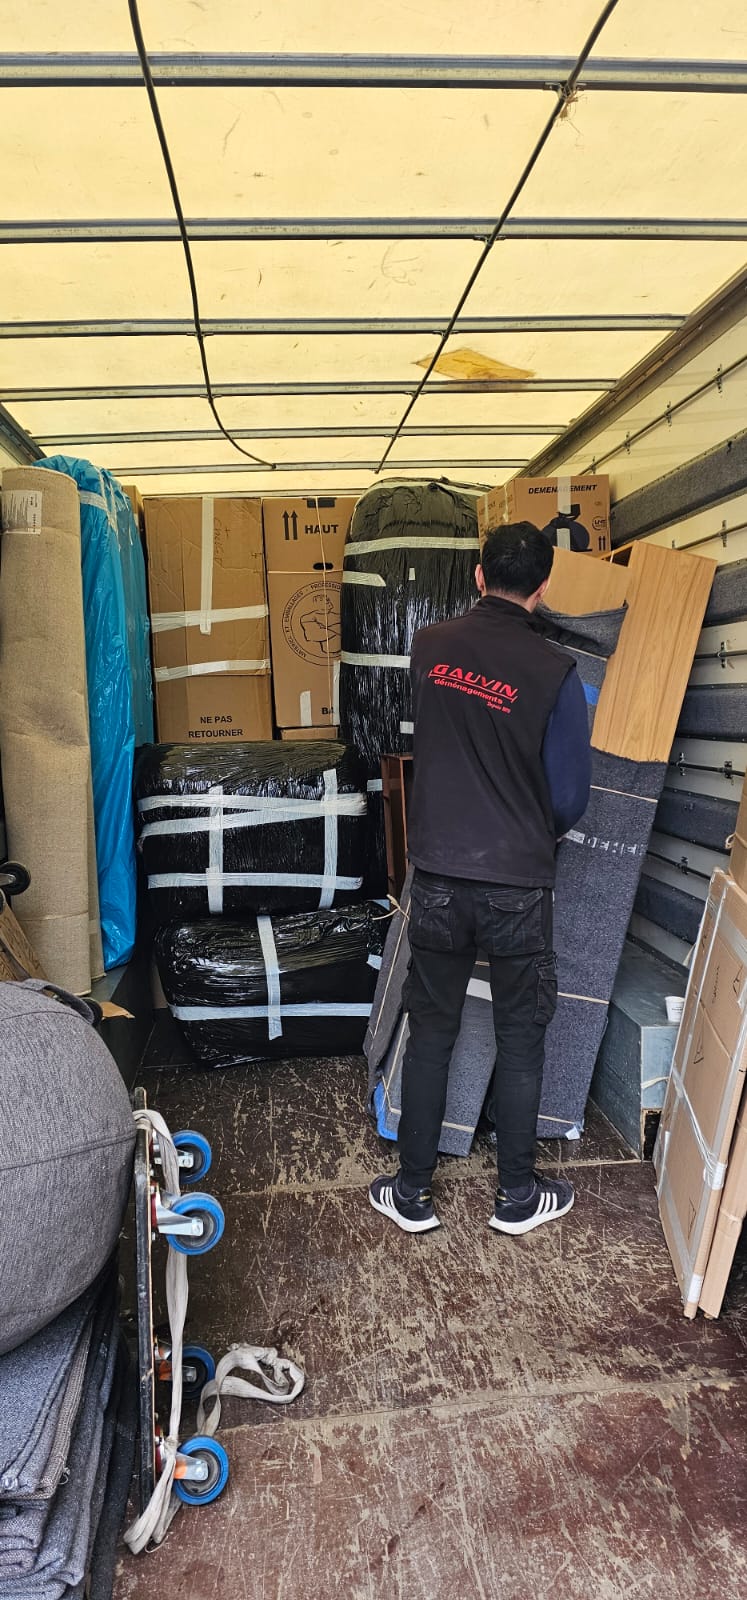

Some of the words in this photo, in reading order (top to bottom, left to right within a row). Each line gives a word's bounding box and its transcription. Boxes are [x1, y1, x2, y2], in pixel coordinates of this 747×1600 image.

[528, 484, 597, 495] DEMENEMENT
[304, 524, 339, 534] HAUT
[310, 582, 341, 590] PROFESSIO
[432, 664, 518, 697] GAUVIN
[434, 678, 503, 704] déménagements
[200, 716, 212, 724] NE
[214, 715, 233, 723] PAS
[188, 729, 243, 738] RETOURNER
